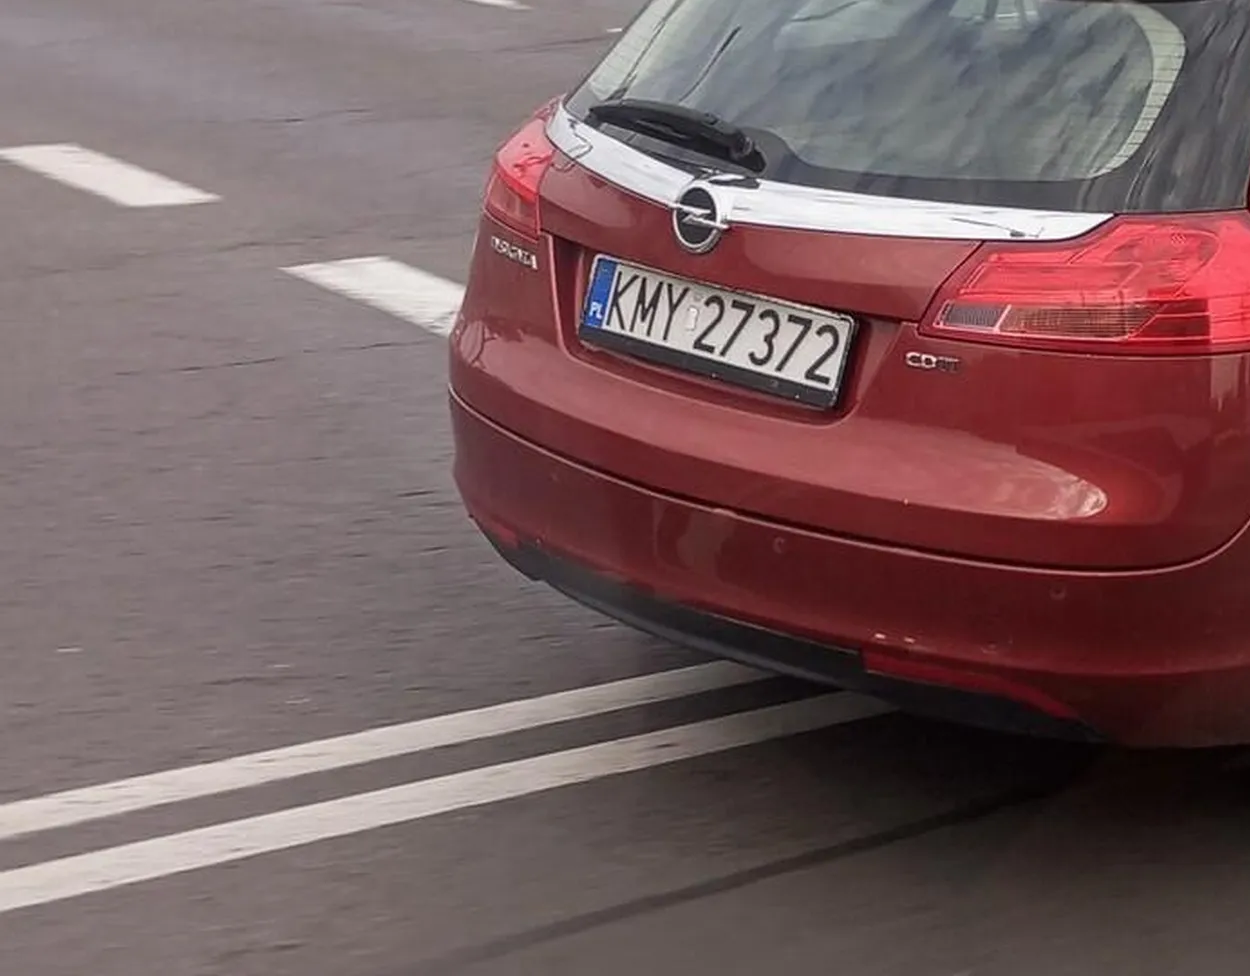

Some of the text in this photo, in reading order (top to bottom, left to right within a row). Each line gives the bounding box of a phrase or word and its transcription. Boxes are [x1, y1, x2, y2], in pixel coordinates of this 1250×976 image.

[588, 302, 603, 320] PL
[606, 270, 841, 385] KMY 27372
